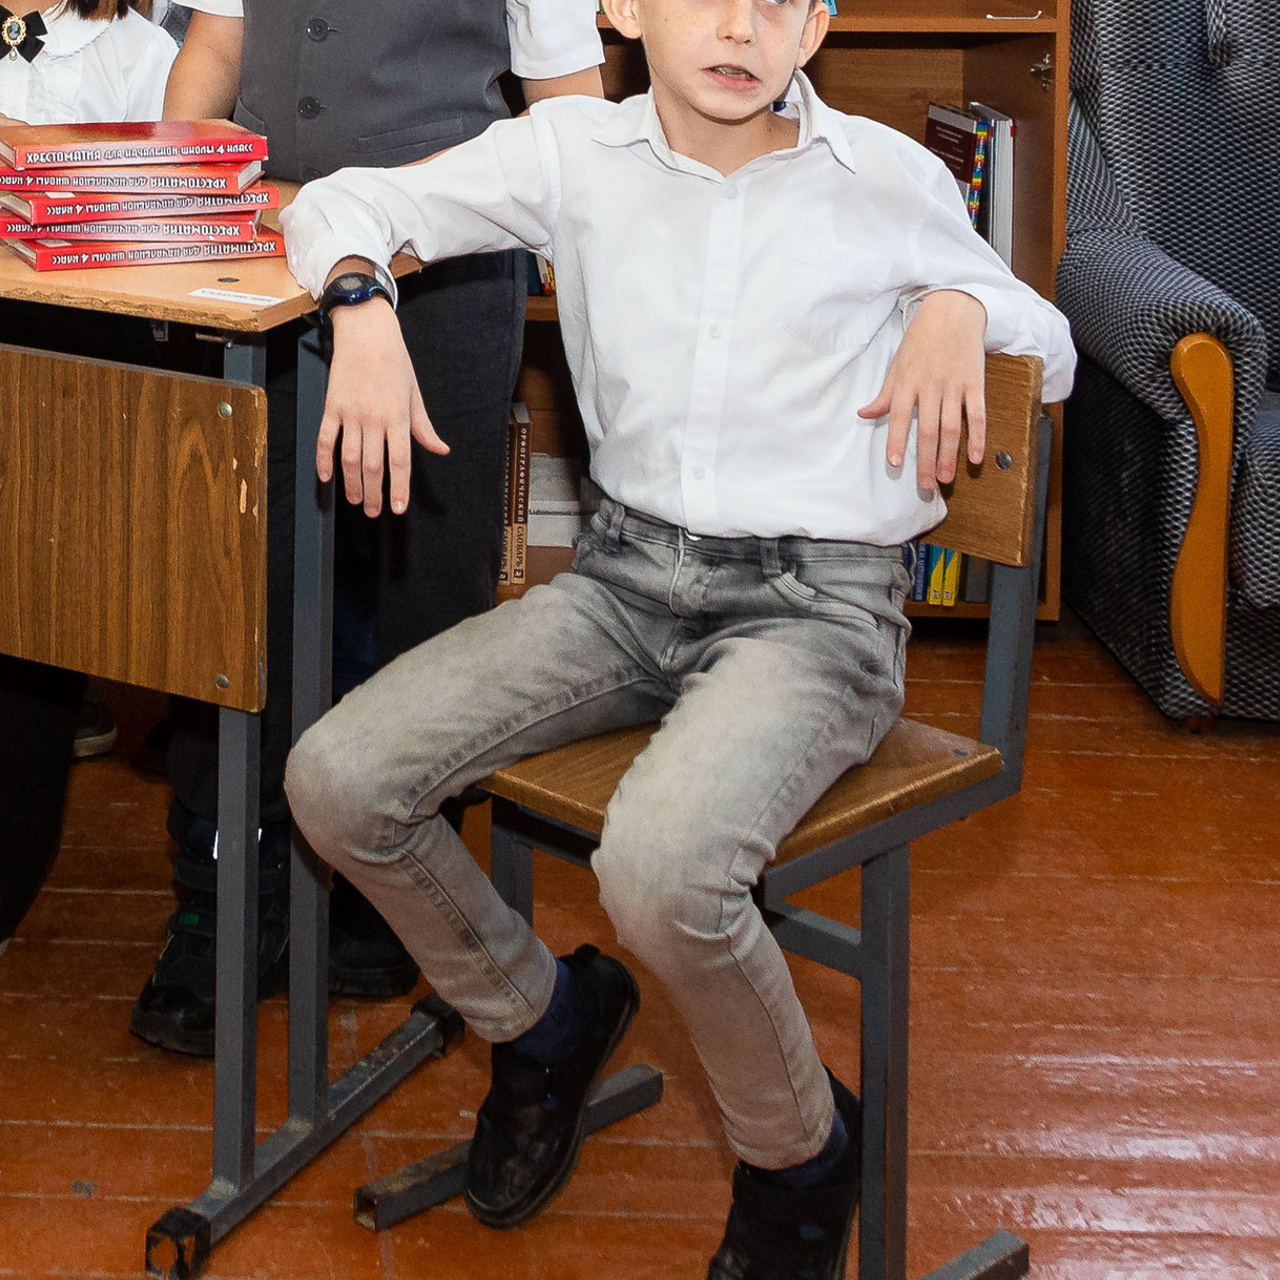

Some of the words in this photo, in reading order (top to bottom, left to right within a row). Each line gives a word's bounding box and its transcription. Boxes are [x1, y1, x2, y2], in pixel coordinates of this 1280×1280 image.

[26, 148, 101, 164] ХРЕСТОМАТИЯ
[216, 144, 224, 154] 4
[25, 176, 33, 186] 4
[150, 177, 227, 189] ХРЕСТОМАТИЯ
[197, 192, 269, 206] ХРЕСТОМАТИЯ
[75, 204, 83, 214] 4
[163, 224, 240, 236] ХРЕСТОМАТИЯ
[203, 241, 277, 256] ХРЕСТОМАТИЯ
[81, 254, 89, 264] 4
[517, 427, 527, 523] ОРФОГРАФИЧЕСКИЙ
[514, 526, 524, 567] СЛОВАРЬ
